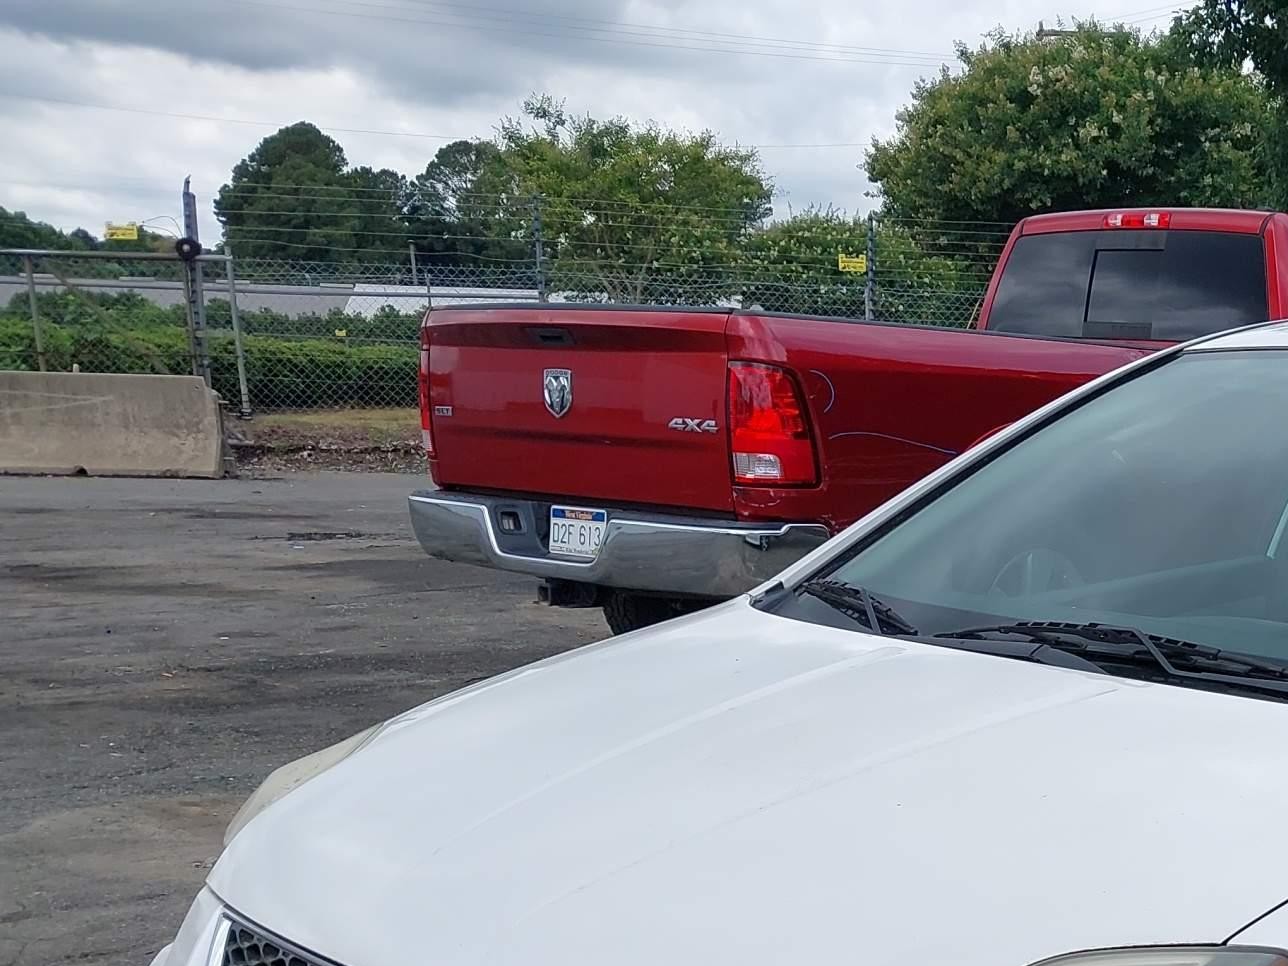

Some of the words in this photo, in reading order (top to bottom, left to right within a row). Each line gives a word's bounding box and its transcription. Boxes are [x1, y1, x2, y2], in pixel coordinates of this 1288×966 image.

[668, 418, 719, 433] 4X4
[552, 523, 575, 544] D2F
[579, 525, 601, 547] 613
